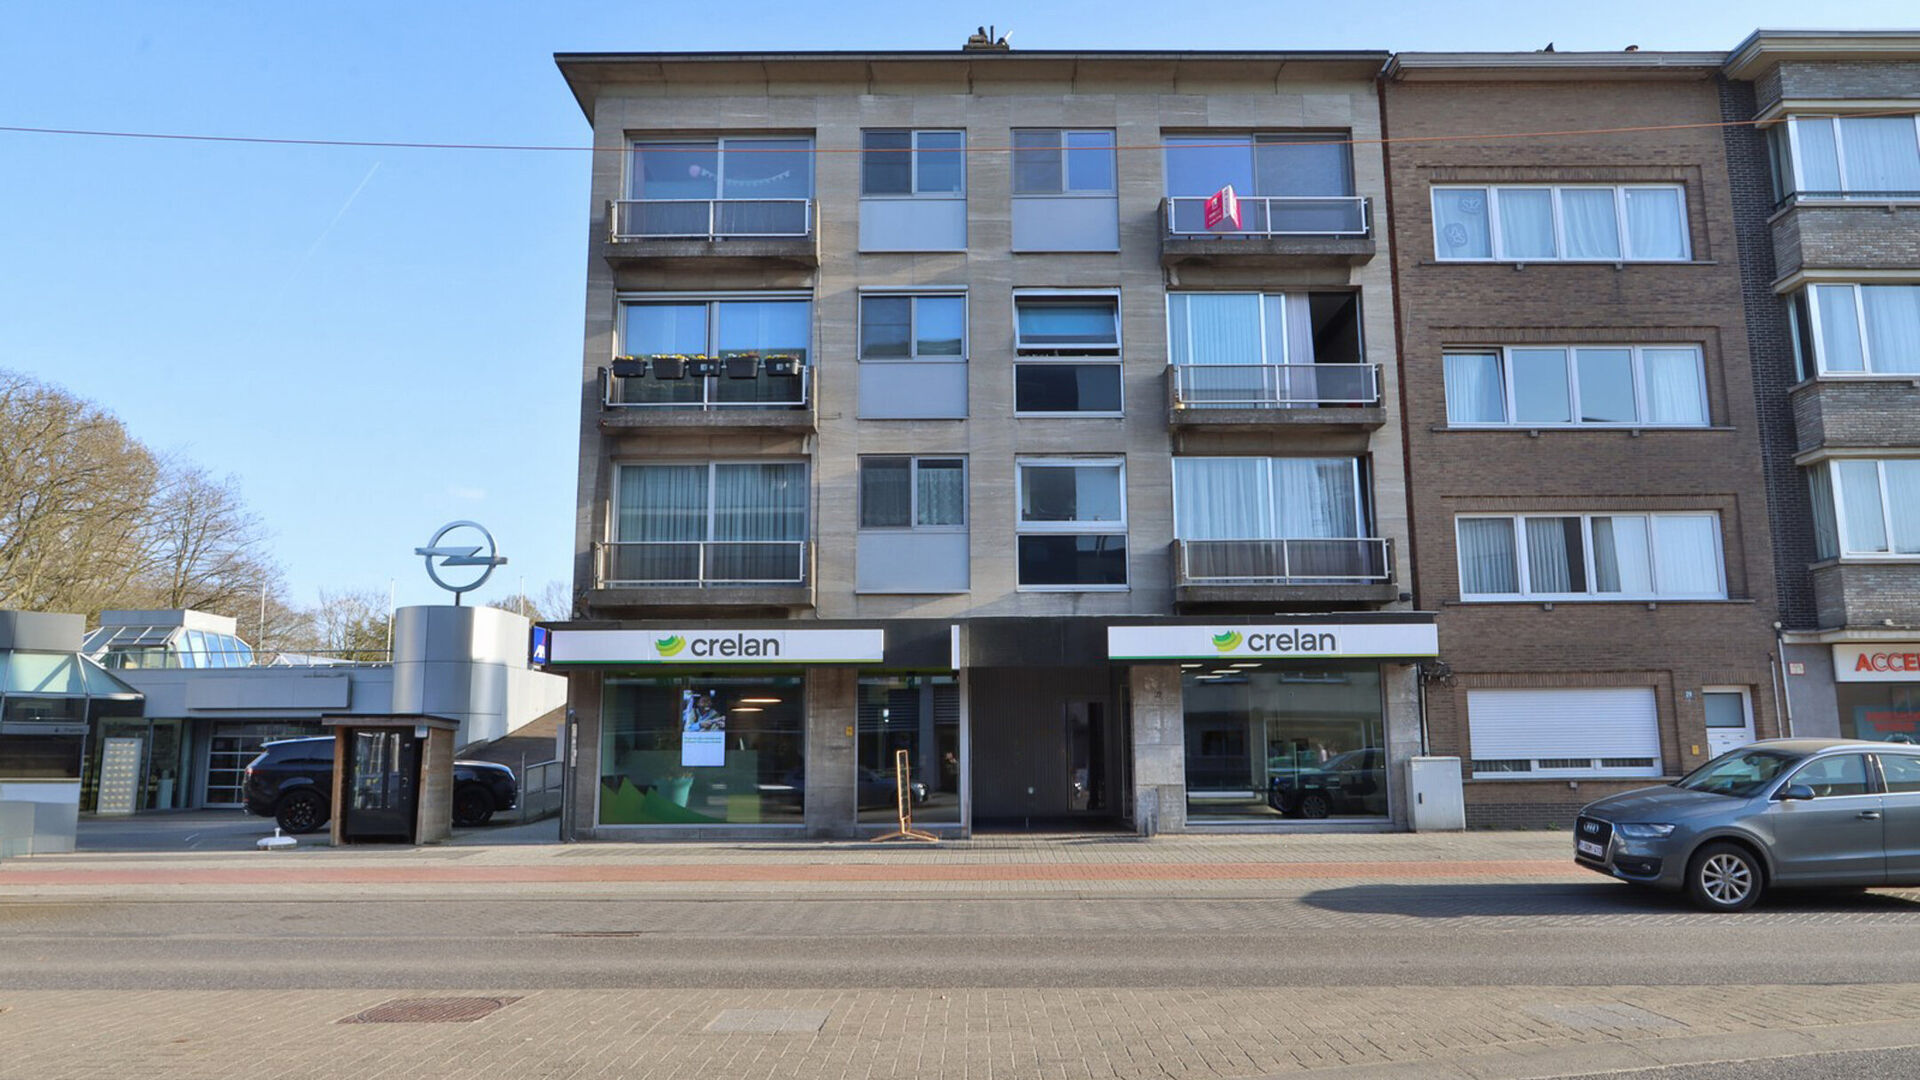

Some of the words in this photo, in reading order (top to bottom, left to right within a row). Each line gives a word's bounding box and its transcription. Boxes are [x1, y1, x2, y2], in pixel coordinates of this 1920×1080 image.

[691, 633, 780, 656] crelan
[1248, 628, 1336, 651] crelan
[1855, 653, 1920, 672] ACCE
